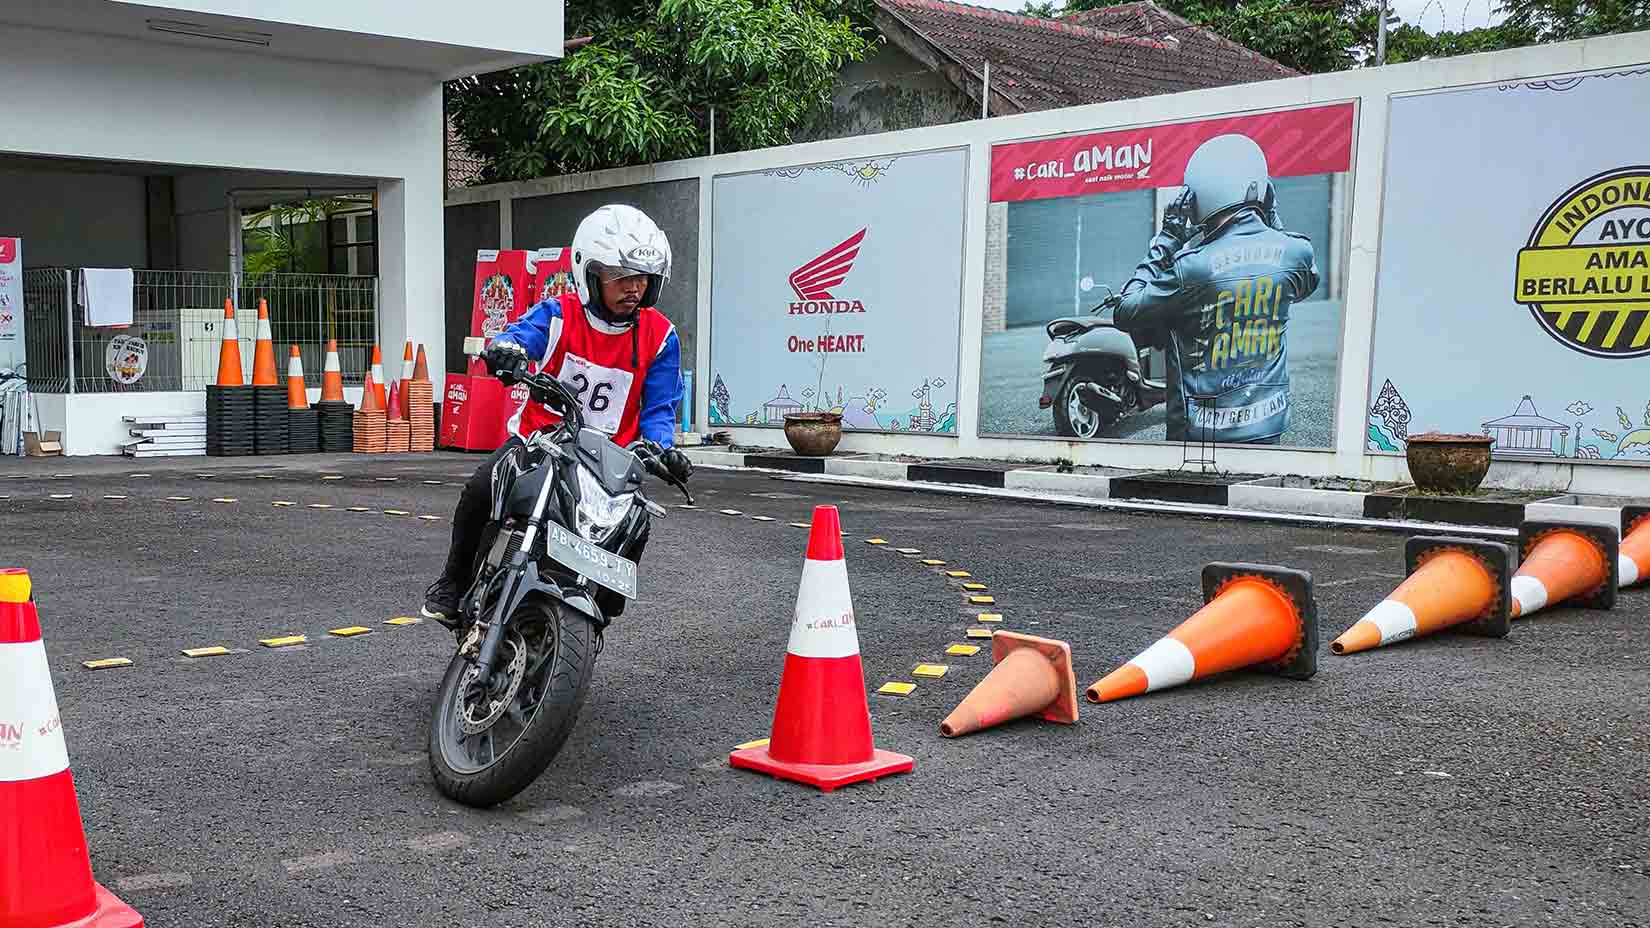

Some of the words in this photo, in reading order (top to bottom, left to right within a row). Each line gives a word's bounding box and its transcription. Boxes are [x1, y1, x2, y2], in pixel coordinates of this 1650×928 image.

[1585, 251, 1649, 270] AMA
[1522, 275, 1632, 296] BERLALU
[788, 300, 866, 314] HONDA
[788, 335, 814, 352] One
[817, 334, 865, 352] HEART.
[572, 373, 613, 412] 26
[551, 527, 568, 545] AB
[574, 541, 608, 568] 4659
[615, 558, 633, 577] TY
